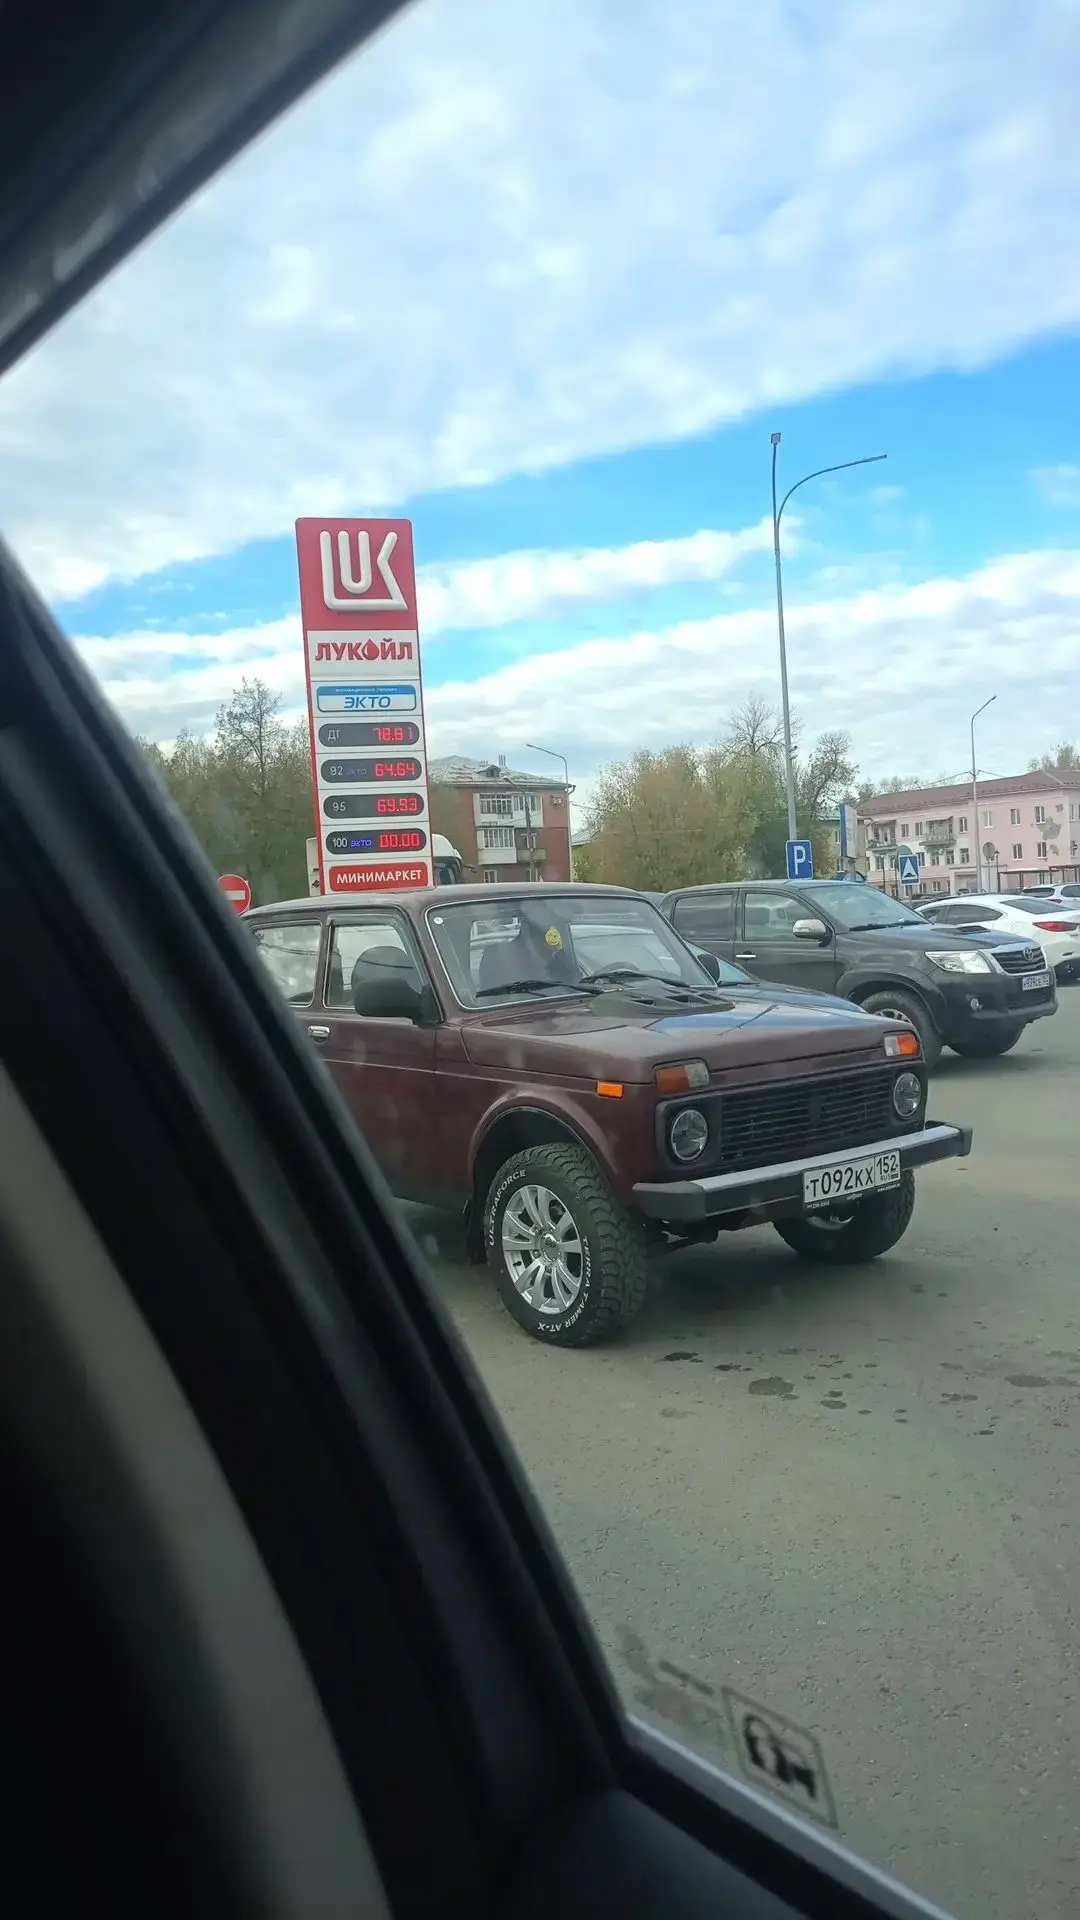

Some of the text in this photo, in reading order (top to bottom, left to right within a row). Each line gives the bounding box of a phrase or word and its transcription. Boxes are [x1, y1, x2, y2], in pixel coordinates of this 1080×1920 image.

[315, 637, 413, 661] ЛУКОЙЛ
[343, 696, 391, 709] ЭКТО
[327, 729, 341, 742] ДТ
[330, 766, 344, 776] 92
[375, 763, 416, 777] 64.64
[332, 798, 418, 813] 95 69.93
[332, 838, 348, 848] 100
[350, 839, 372, 848] ЭКТО
[336, 869, 422, 884] МИНИМАРКЕТ
[876, 1154, 897, 1175] 152
[488, 1169, 527, 1247] ULTRAFORCE
